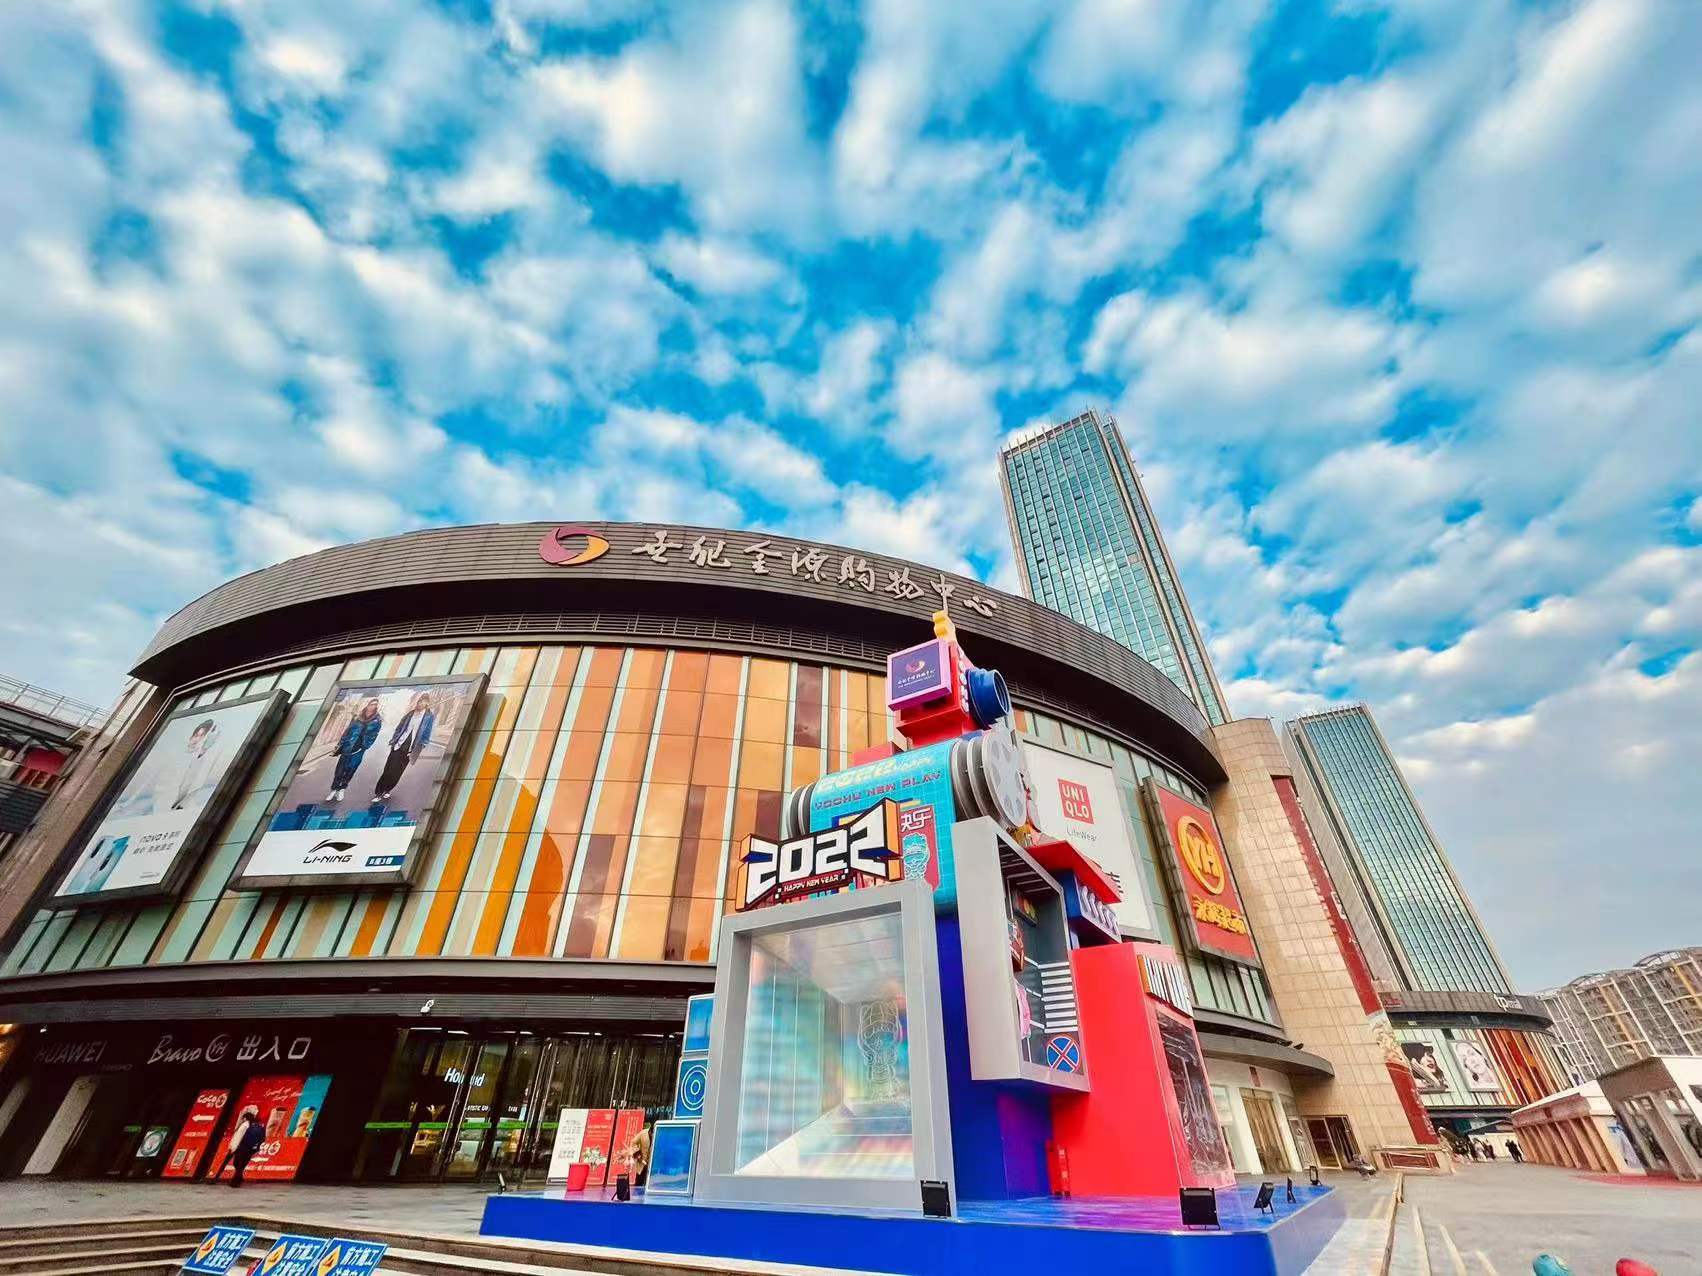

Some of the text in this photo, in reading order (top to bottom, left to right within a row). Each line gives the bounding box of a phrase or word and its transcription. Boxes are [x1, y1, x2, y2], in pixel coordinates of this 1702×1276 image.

[1061, 783, 1085, 802] UNI
[1065, 800, 1090, 819] QLO
[302, 854, 353, 864] LI-NING
[746, 804, 887, 904] 2022
[784, 874, 839, 892] HAPPY NEW YEAR
[34, 1041, 108, 1063] HUAWEI
[147, 1034, 202, 1064] Bravo
[237, 1035, 312, 1061] 出入口
[284, 1243, 320, 1261] 前方施工
[343, 1246, 379, 1266] 前方施工
